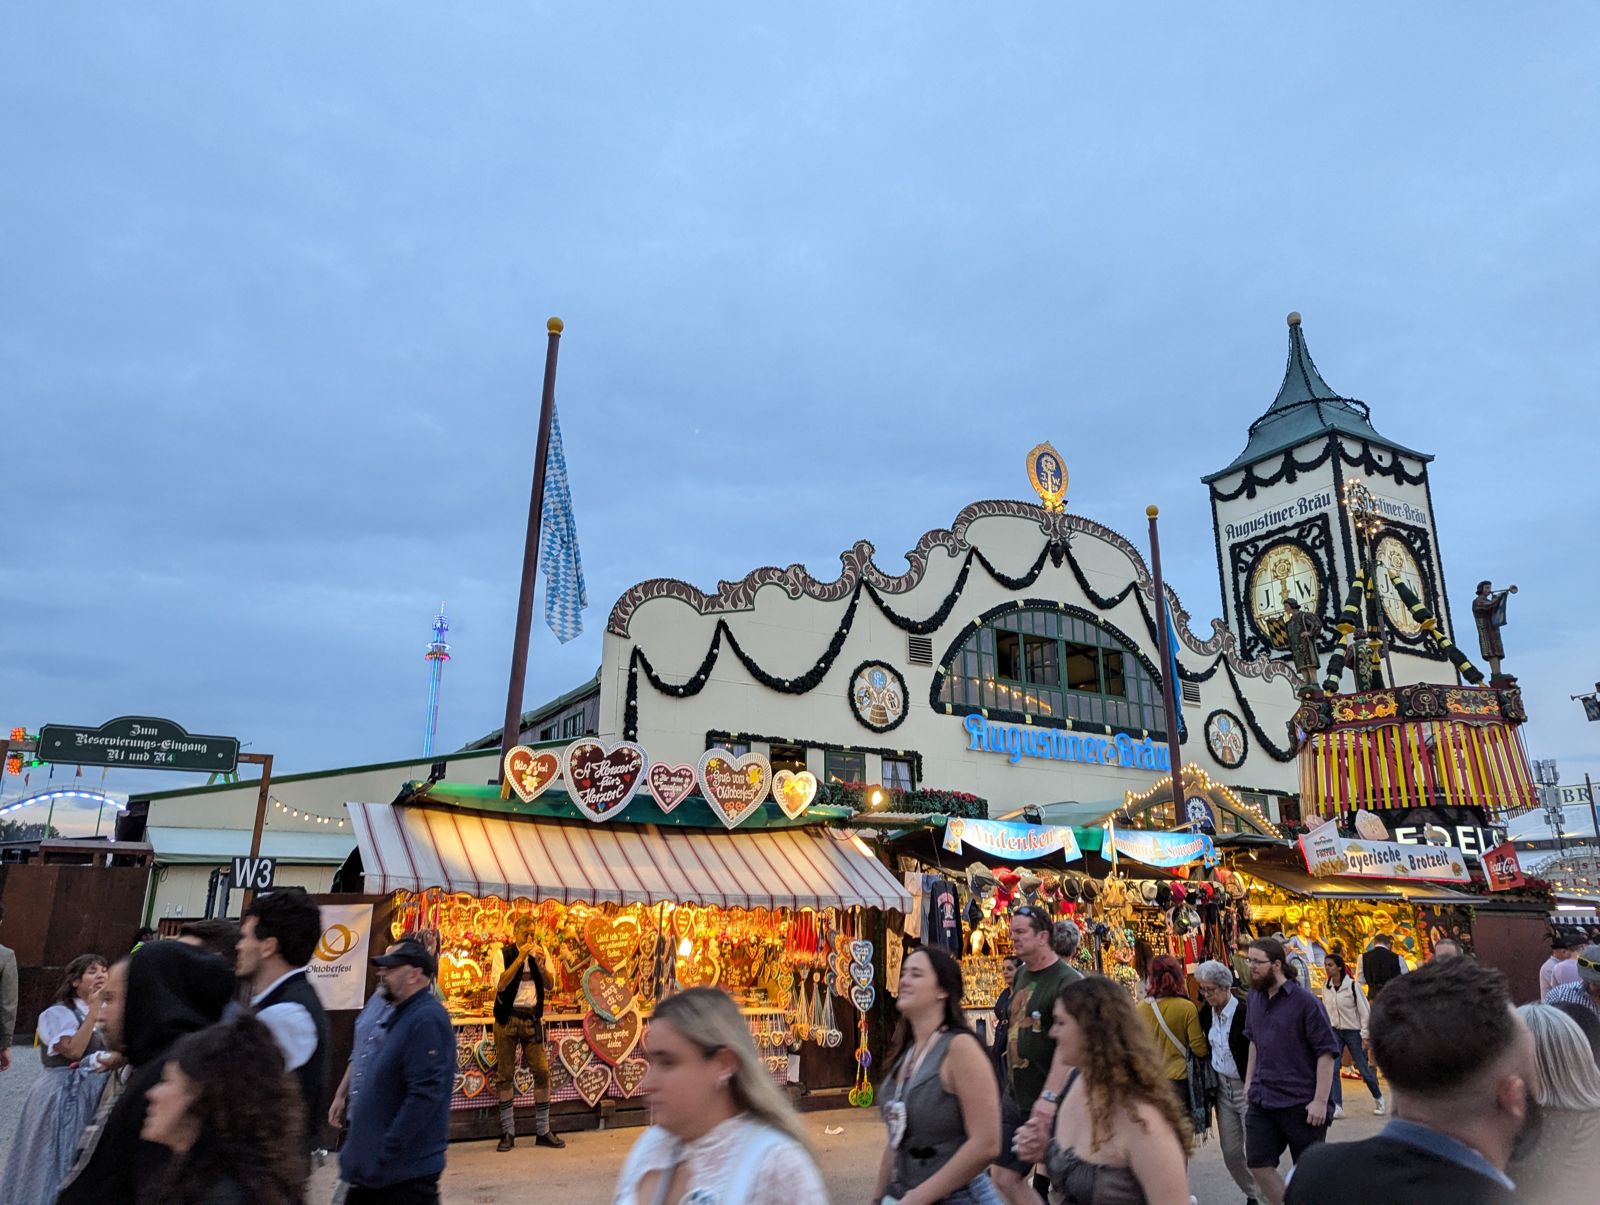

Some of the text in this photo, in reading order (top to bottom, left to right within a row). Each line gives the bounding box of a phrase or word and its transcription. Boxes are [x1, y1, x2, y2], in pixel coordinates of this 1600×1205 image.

[129, 724, 158, 736] Zum
[75, 733, 208, 753] Reservierungs-Eingang
[129, 751, 150, 761] und
[574, 765, 591, 779] A
[712, 771, 745, 787] Gruß vom
[715, 785, 756, 802] Oktoberfest
[970, 823, 1056, 850] Andenken
[1408, 849, 1450, 870] Brotzeit
[235, 858, 272, 888] W3
[305, 964, 352, 974] Oktoberfest
[596, 1032, 612, 1041] meine
